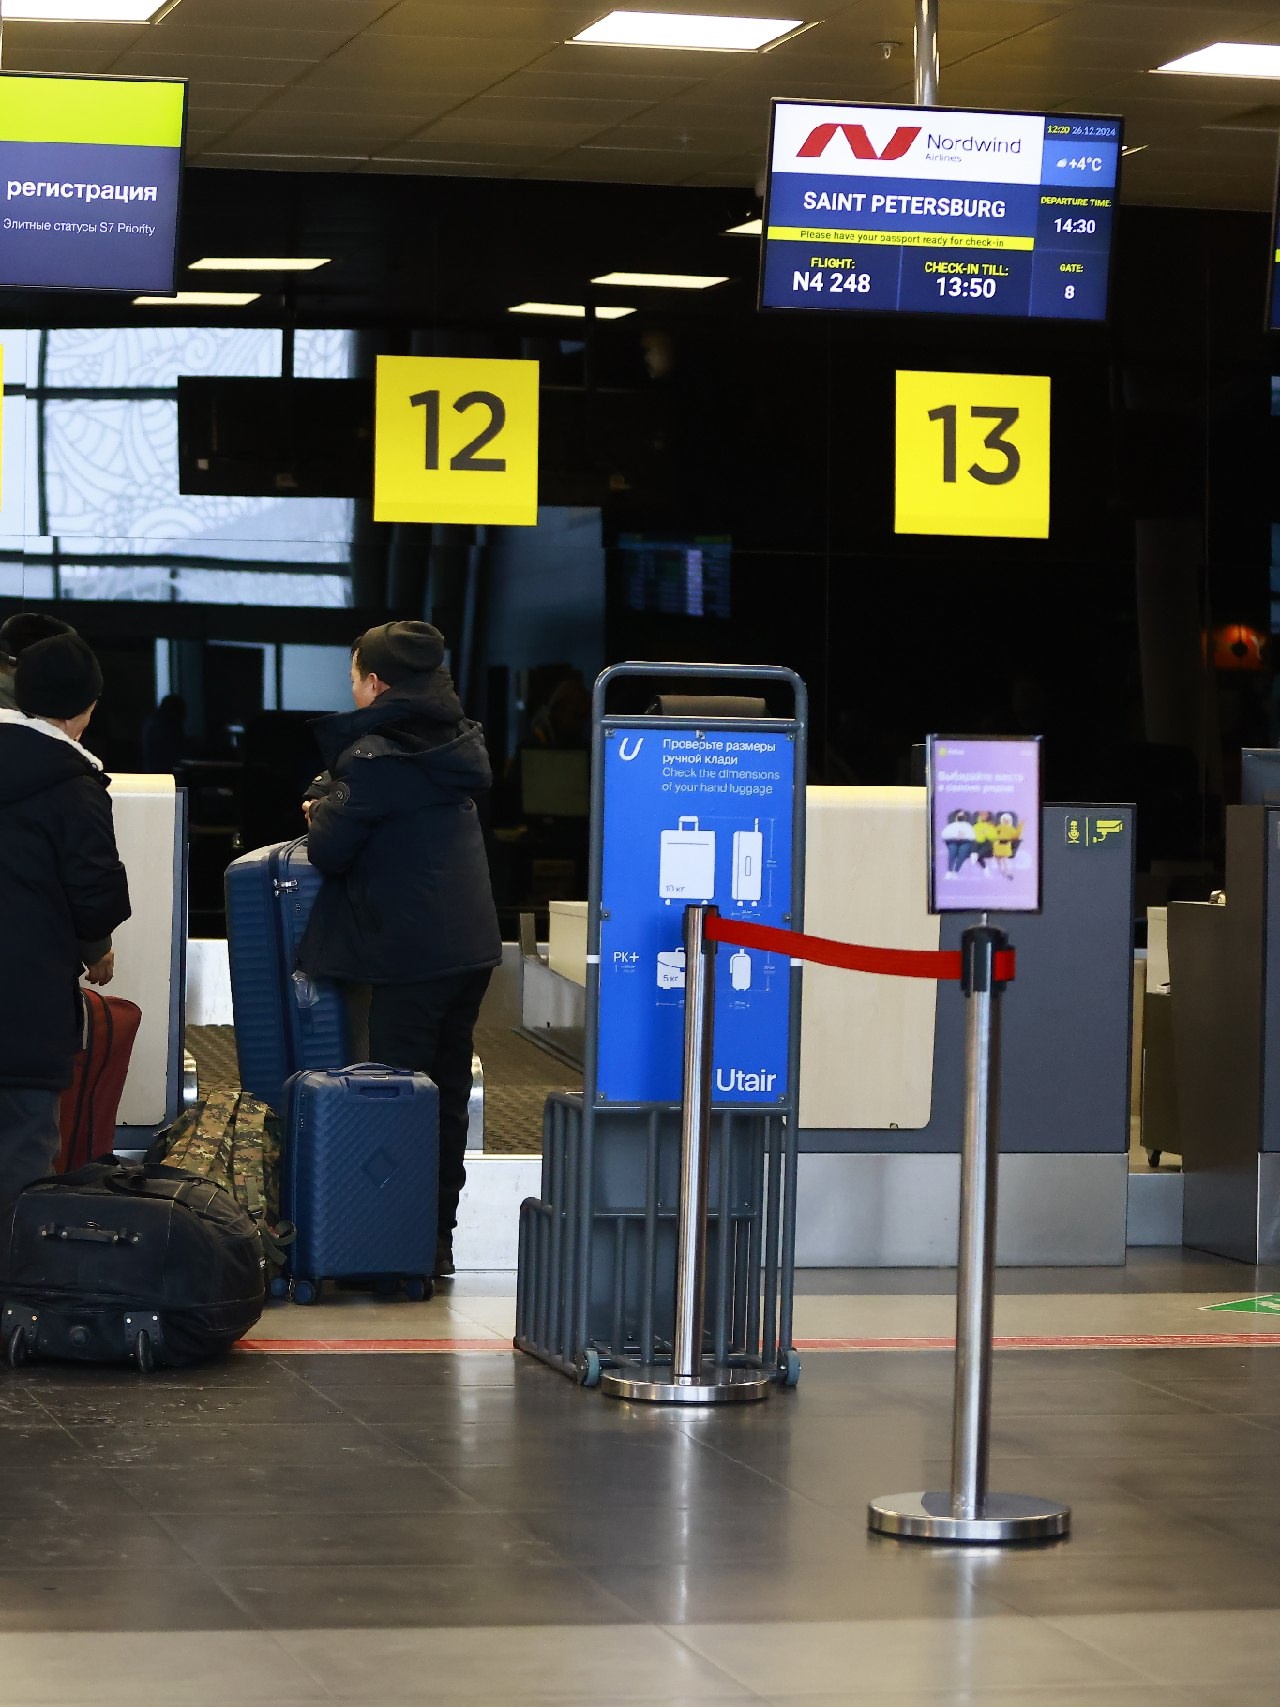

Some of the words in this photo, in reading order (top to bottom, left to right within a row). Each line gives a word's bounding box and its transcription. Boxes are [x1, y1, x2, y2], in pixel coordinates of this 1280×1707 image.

[1072, 126, 1116, 137] 26.12.2024
[926, 133, 1021, 155] Nordwind
[925, 153, 962, 163] Airlines
[6, 178, 158, 204] регистрация
[803, 191, 867, 213] SAINT
[871, 197, 1006, 219] PETERSBURG
[1040, 196, 1089, 207] DEPARTURE
[1089, 198, 1112, 208] TIME:
[3, 217, 52, 231] Элитные
[53, 221, 97, 234] статусы
[99, 221, 115, 233] S7
[117, 222, 156, 236] Priority
[1053, 218, 1096, 234] 14:30
[800, 230, 831, 239] Please
[833, 231, 855, 240] have
[857, 233, 878, 243] your
[880, 234, 921, 245] passport
[923, 236, 948, 246] ready
[950, 235, 963, 245] for
[965, 237, 1004, 247] check-in
[810, 257, 856, 270] FLIGHT:
[924, 261, 980, 275] CHECK-IN
[982, 264, 1009, 277] TILL:
[1059, 263, 1084, 273] GATE:
[792, 271, 824, 292] N4
[829, 272, 871, 293] 248
[936, 277, 996, 299] 13:50
[1064, 285, 1075, 300] 8
[409, 389, 507, 473] 12
[927, 404, 1021, 486] 13
[663, 738, 724, 752] Проверьте
[726, 741, 776, 753] размеры
[662, 754, 702, 765] ручной
[704, 755, 738, 766] клади
[662, 767, 697, 778] Check
[699, 768, 716, 778] the
[718, 769, 780, 780] dimensions
[661, 781, 673, 791] of
[674, 784, 699, 794] your
[699, 782, 728, 793] hand
[729, 783, 773, 796] luggage
[716, 1068, 777, 1092] Utair
